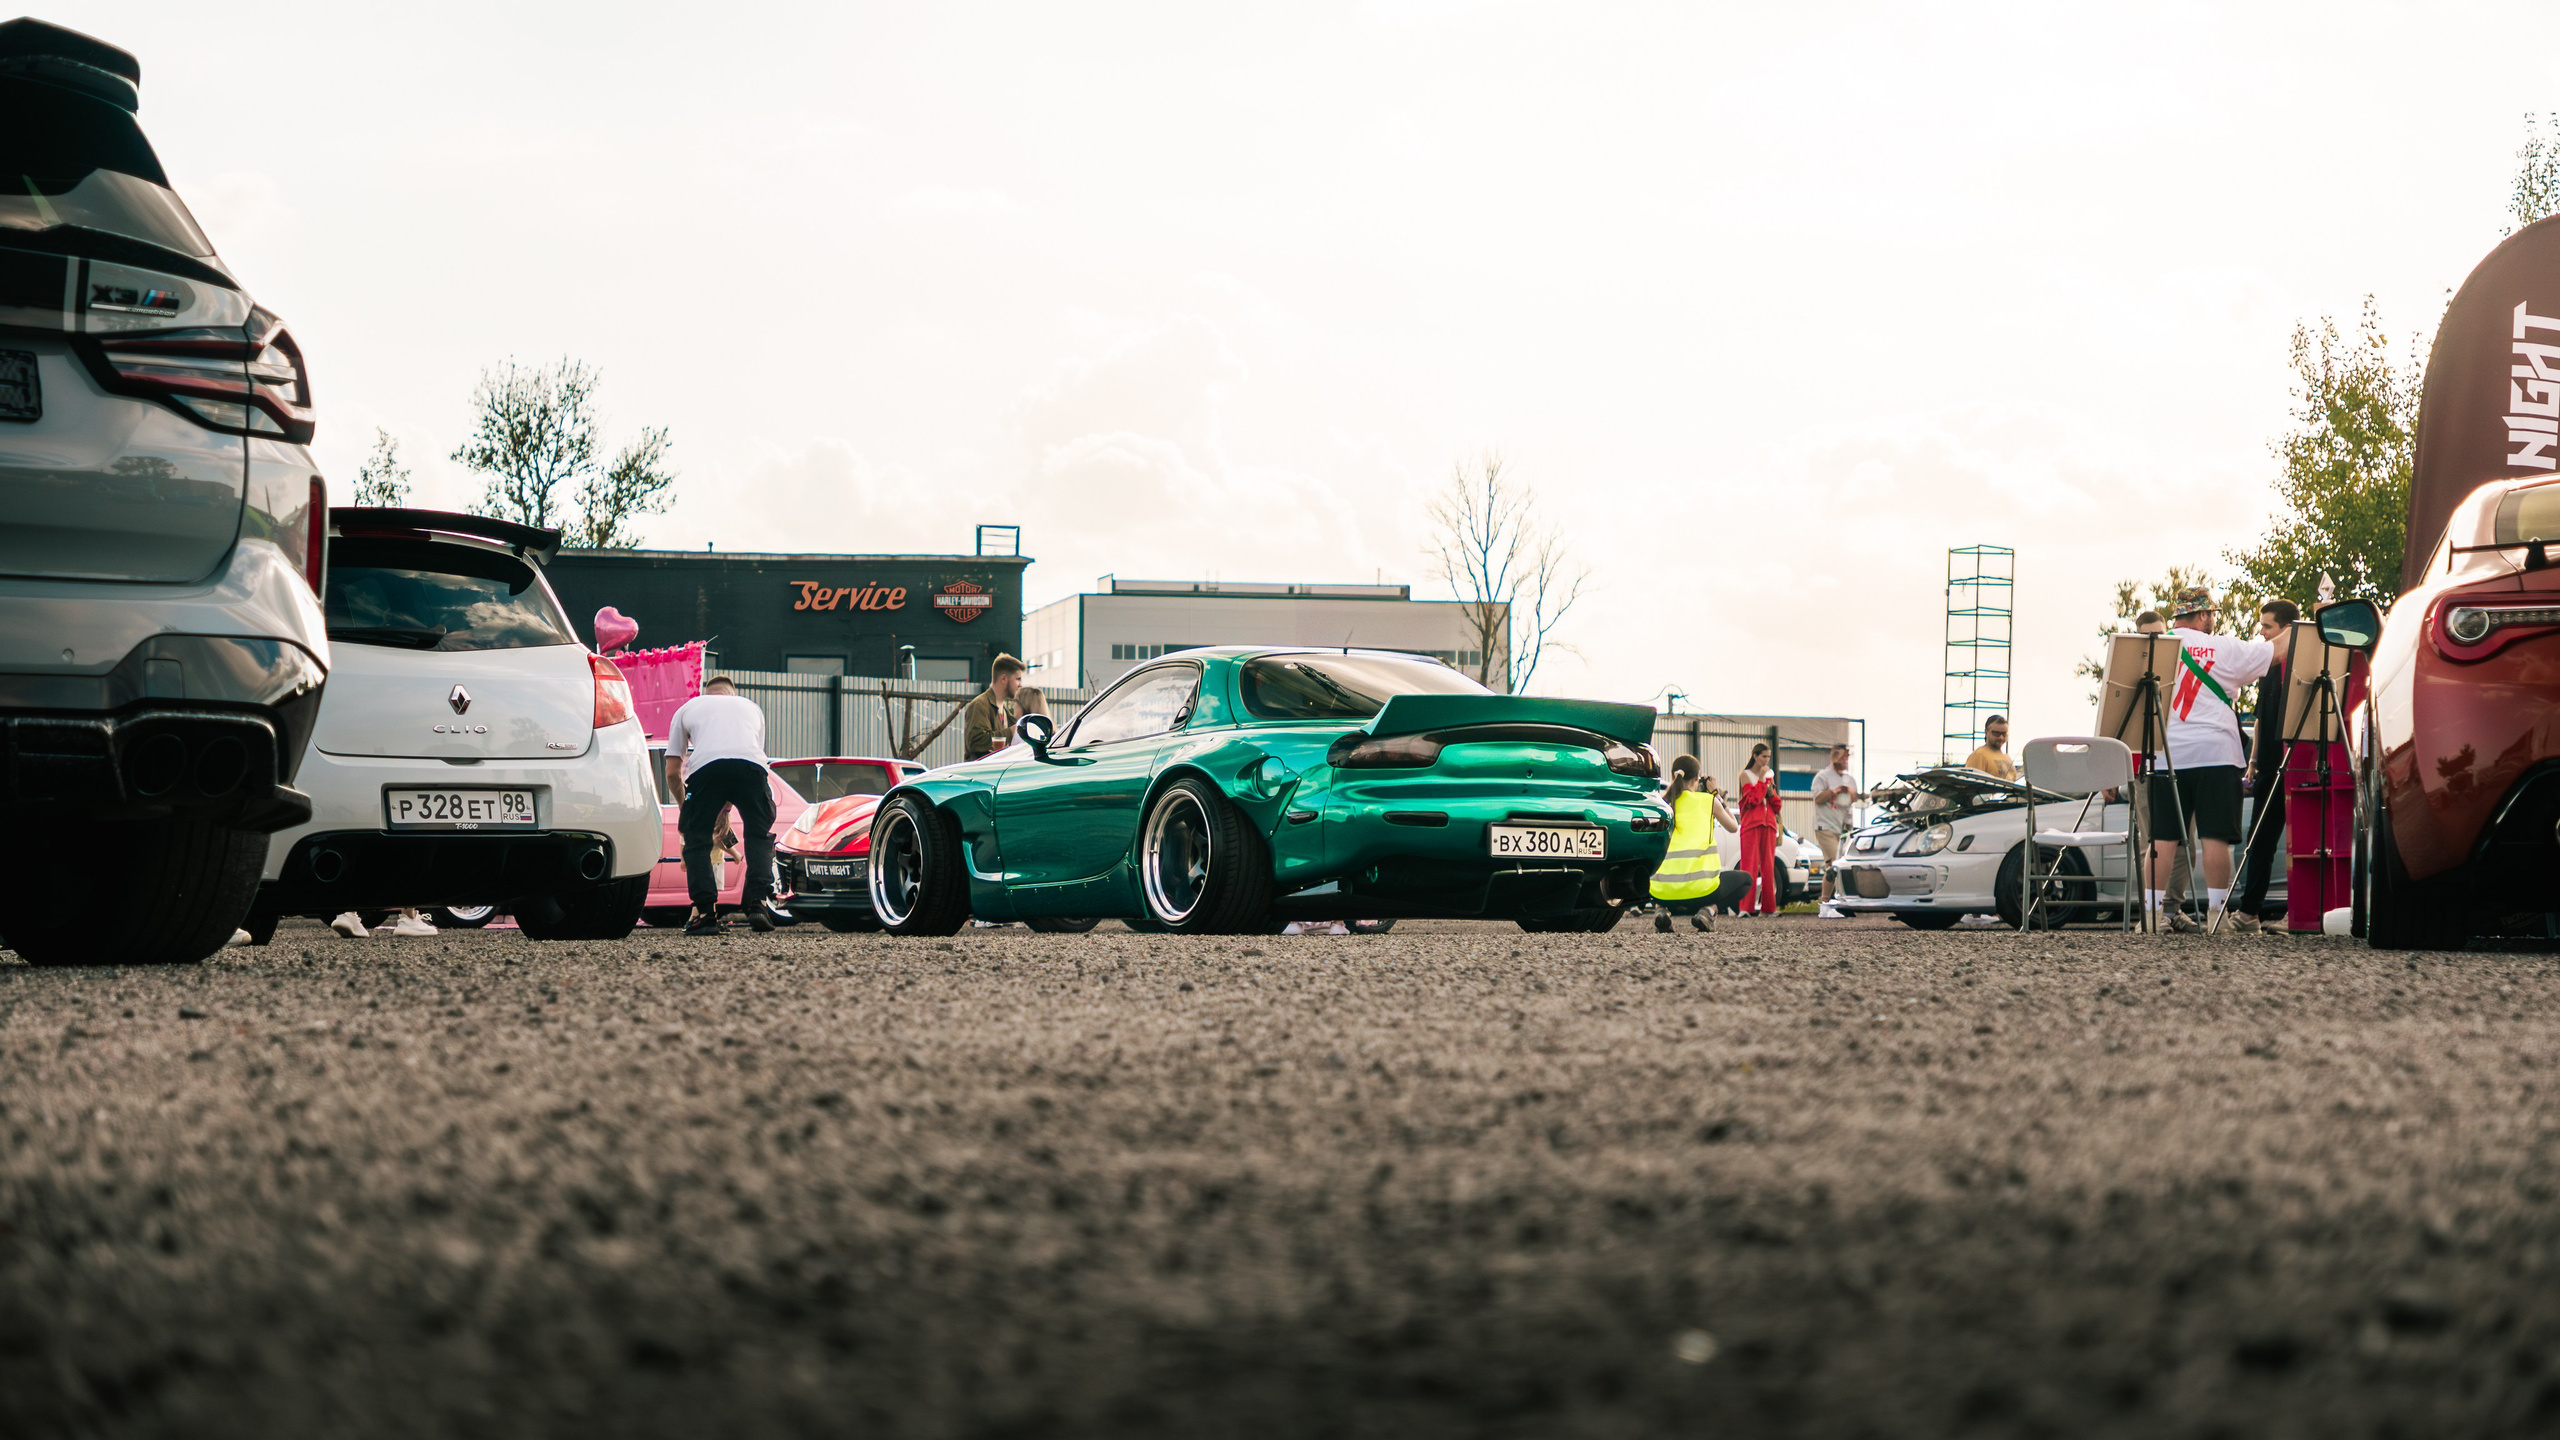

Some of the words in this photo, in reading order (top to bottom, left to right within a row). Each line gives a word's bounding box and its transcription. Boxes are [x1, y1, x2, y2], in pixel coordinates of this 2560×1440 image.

[92, 284, 138, 305] X3
[2502, 300, 2560, 471] NIGHT
[949, 583, 977, 593] MOTOR
[790, 581, 907, 611] Service
[936, 596, 990, 606] HARLEY-DAVIDSON
[949, 608, 977, 620] CYCLES
[433, 724, 488, 734] CLIO
[503, 793, 526, 813] 98
[503, 813, 520, 821] RUS
[1579, 831, 1597, 848] 42
[809, 864, 829, 876] WHITE
[829, 864, 851, 876] NIGHT
